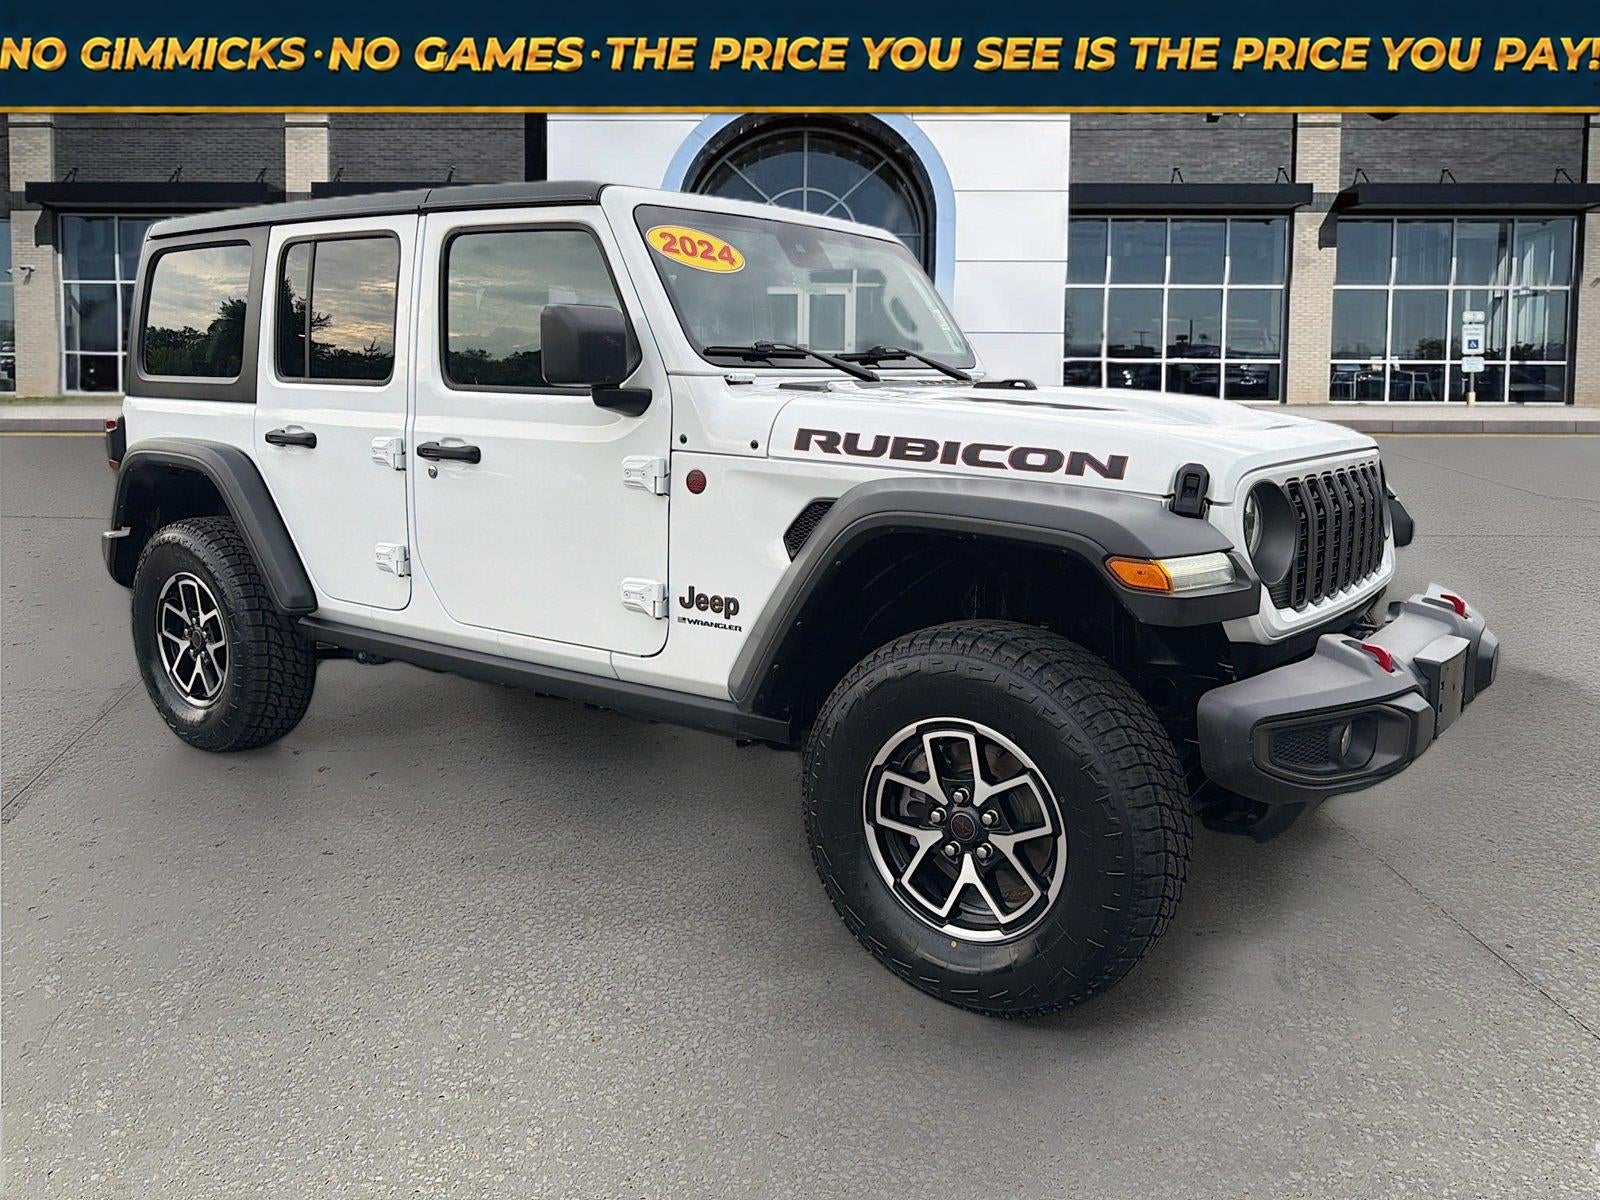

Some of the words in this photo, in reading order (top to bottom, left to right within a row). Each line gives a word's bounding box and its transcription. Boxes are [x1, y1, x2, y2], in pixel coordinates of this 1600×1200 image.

[659, 231, 737, 268] 2024
[793, 427, 1129, 480] RUBICON
[678, 585, 740, 620] Jeep
[686, 617, 743, 632] WRANGLER
